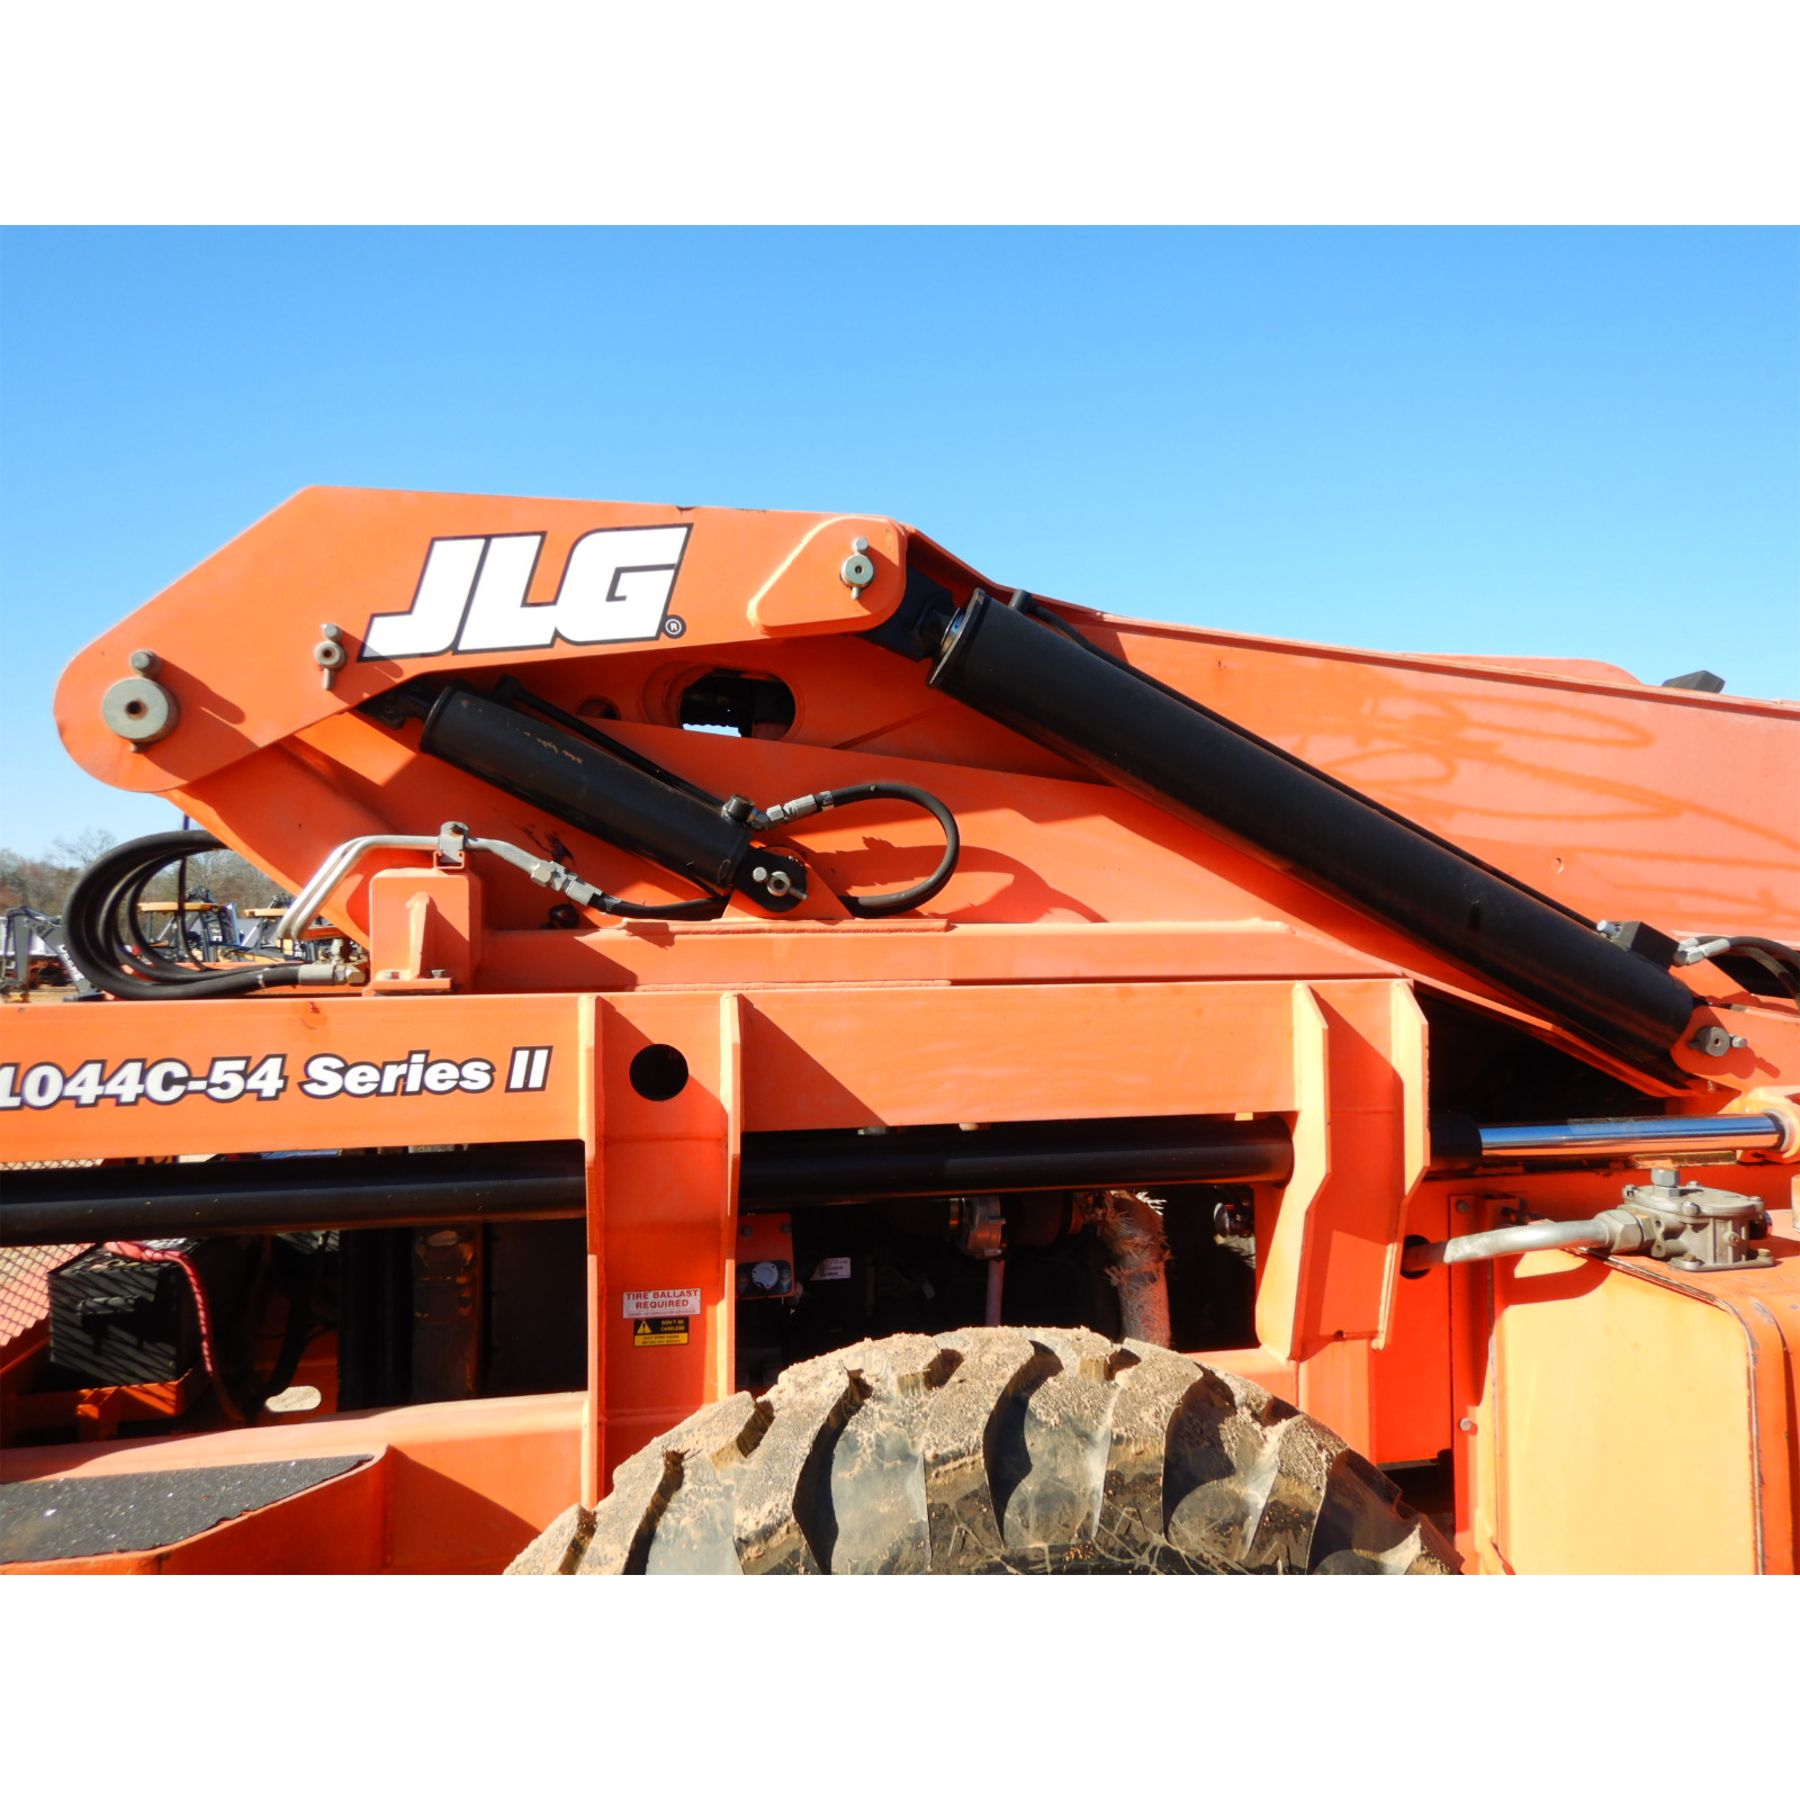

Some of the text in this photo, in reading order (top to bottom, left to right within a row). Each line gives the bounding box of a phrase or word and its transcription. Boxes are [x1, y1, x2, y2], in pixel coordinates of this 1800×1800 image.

[357, 523, 693, 662] JLG
[0, 1045, 553, 1110] 1044C-54 Series II
[626, 1290, 698, 1301] TIRE BALLAST
[635, 1300, 689, 1309] REQUIRED
